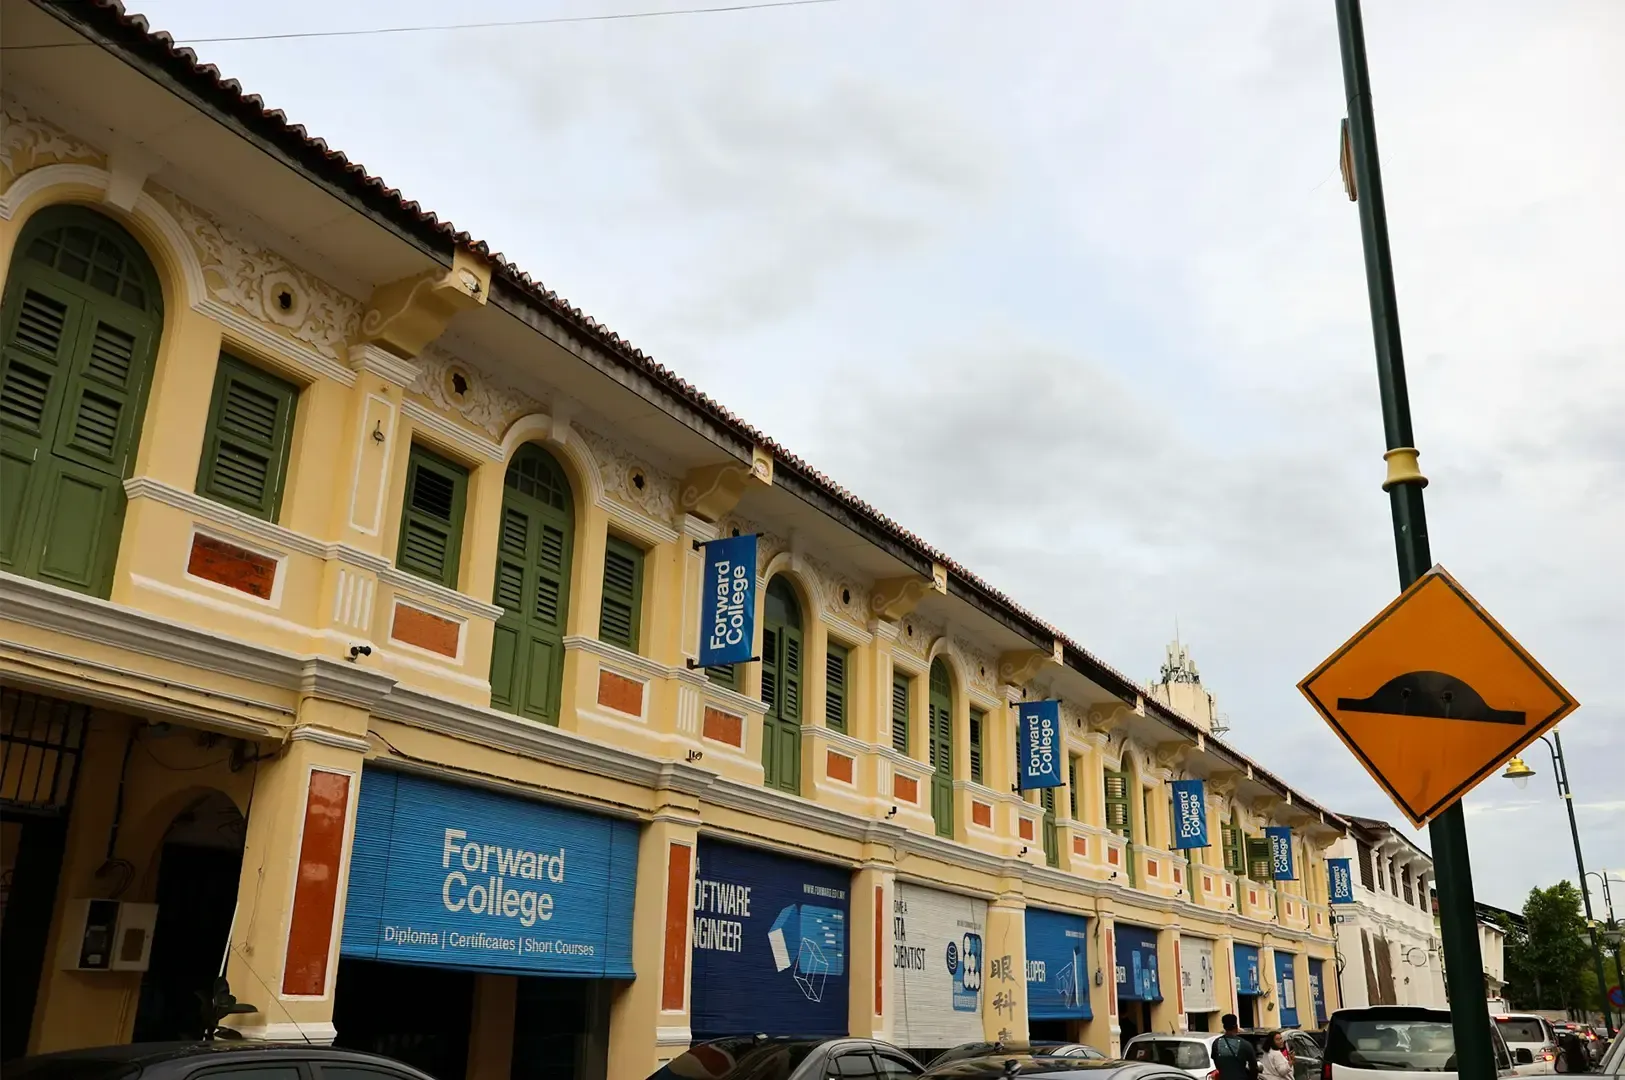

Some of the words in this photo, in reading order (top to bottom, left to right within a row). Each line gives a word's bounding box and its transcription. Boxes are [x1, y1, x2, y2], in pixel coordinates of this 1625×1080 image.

[710, 560, 730, 650] Forward
[726, 565, 749, 645] College
[1027, 715, 1040, 777] Forward
[1040, 719, 1054, 774] College
[1178, 791, 1191, 838] Forward
[1189, 794, 1200, 836] College
[442, 827, 564, 883] Forward
[1280, 838, 1288, 872] College
[442, 871, 554, 927] College
[1332, 865, 1342, 898] Forward
[1341, 868, 1349, 897] College
[384, 926, 438, 945] Diploma
[449, 932, 515, 950] Certificates
[524, 938, 552, 953] Short
[554, 940, 594, 956] Courses
